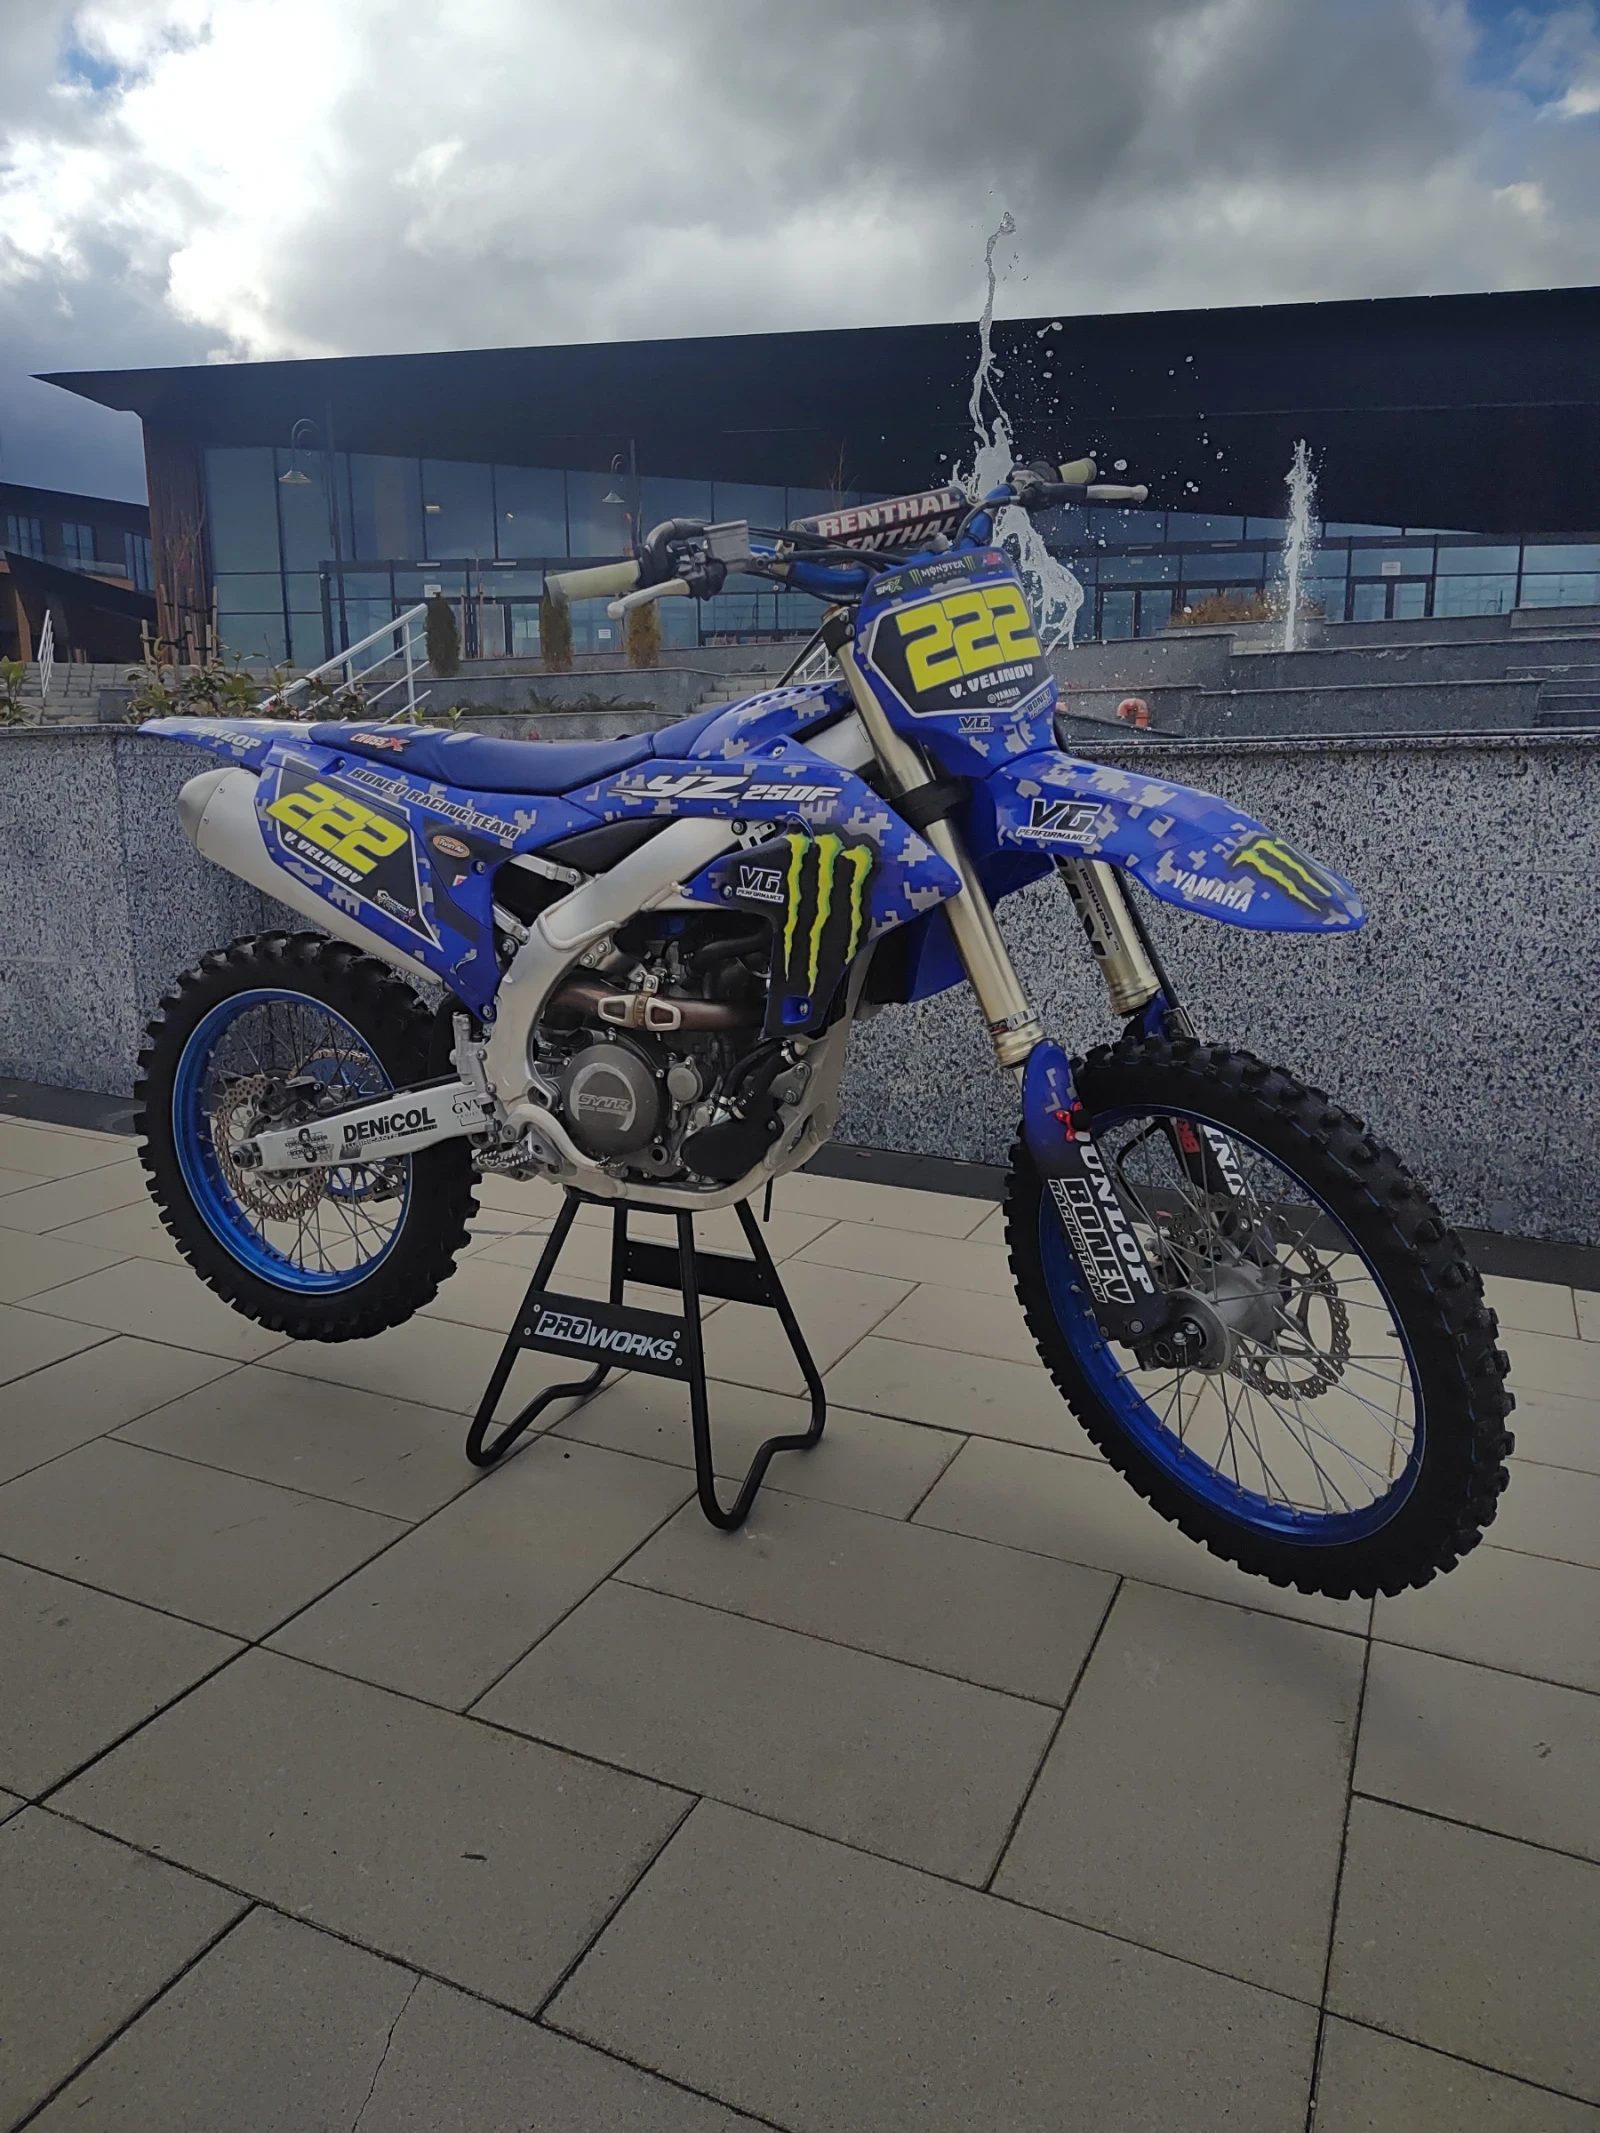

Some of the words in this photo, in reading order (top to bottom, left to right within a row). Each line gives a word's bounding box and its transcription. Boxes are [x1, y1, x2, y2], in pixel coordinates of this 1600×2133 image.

[817, 493, 960, 538] RENTHAL
[830, 517, 957, 551] ENTHAL
[896, 586, 1042, 693] 222
[949, 684, 967, 699] V.
[967, 664, 1033, 692] VELINOV
[996, 687, 1021, 701] YAMAHA
[188, 726, 262, 749] DUNLOP
[958, 716, 991, 730] VG
[349, 768, 407, 797] BONEV
[405, 790, 472, 822] RACING
[469, 812, 521, 841] TEAM
[611, 775, 749, 800] YZ
[741, 784, 843, 802] 250F
[266, 783, 409, 874] 222
[1028, 798, 1104, 832] VG
[1015, 826, 1098, 845] PERFORMANCE
[284, 832, 295, 845] V.
[300, 840, 363, 884] VELINOV
[738, 865, 783, 892] VG
[1173, 868, 1252, 914] YAMAHA
[1079, 868, 1113, 941] Technical
[1048, 1178, 1084, 1251] RACING
[1075, 1249, 1108, 1303] TEAM
[1060, 1177, 1136, 1303] BONEV
